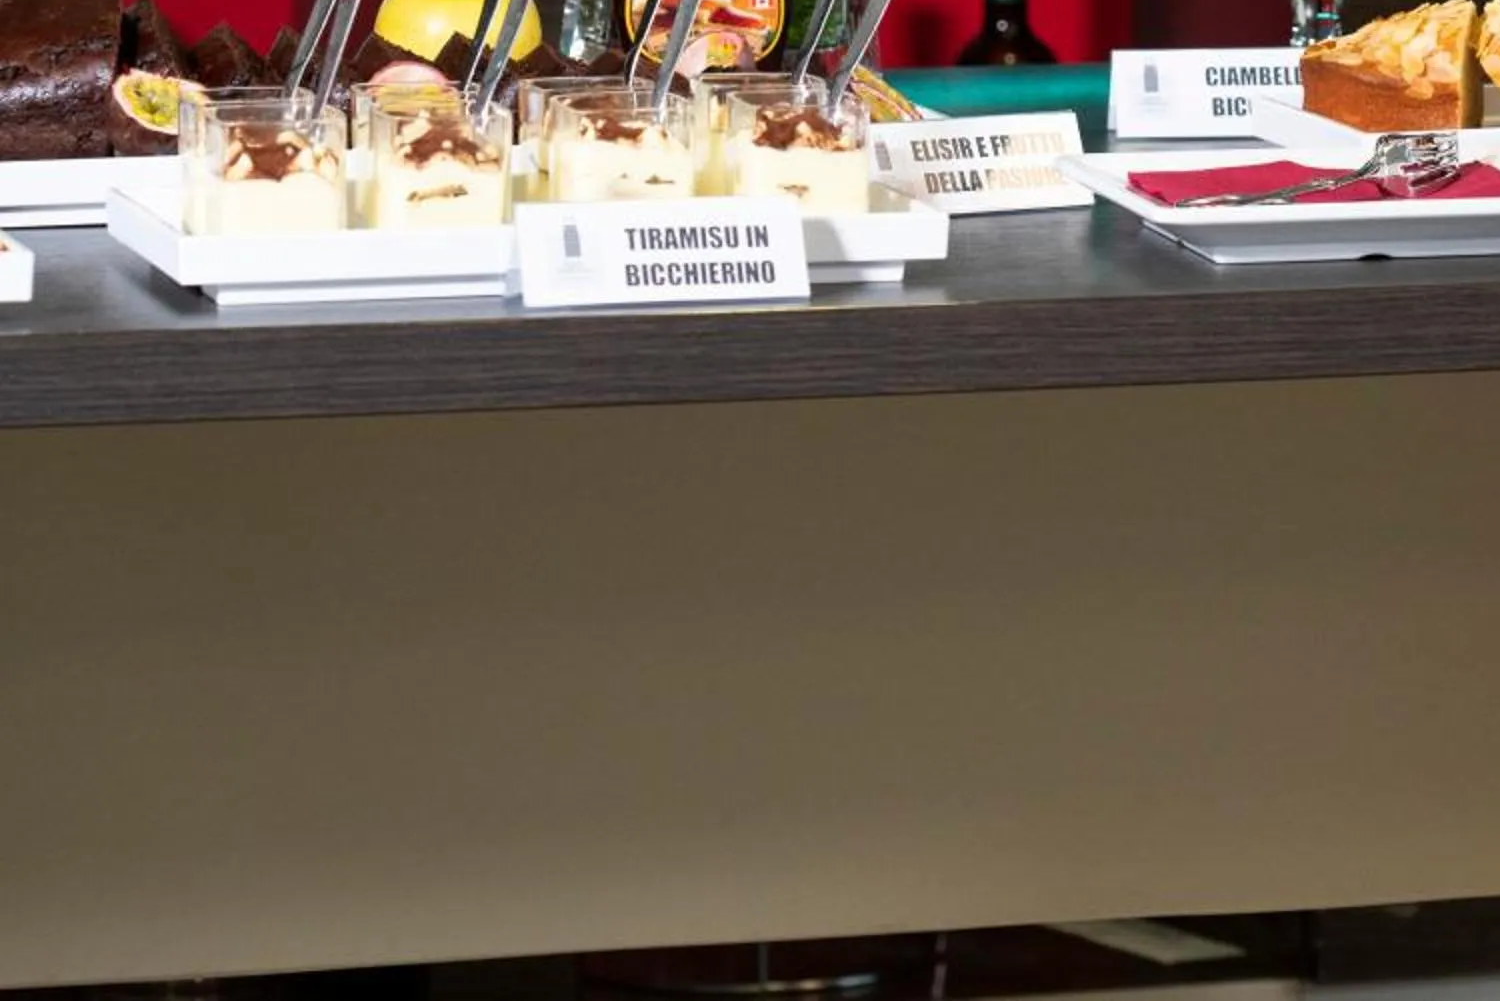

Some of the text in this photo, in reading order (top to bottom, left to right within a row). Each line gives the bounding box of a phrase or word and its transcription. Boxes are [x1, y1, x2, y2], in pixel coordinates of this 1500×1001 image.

[1212, 97, 1252, 116] BIC
[910, 132, 1065, 162] ELISIR E FRUTTO
[924, 169, 984, 194] DELLA
[624, 225, 769, 250] TIRAMISU IN
[625, 260, 775, 286] BICCHIERINO
